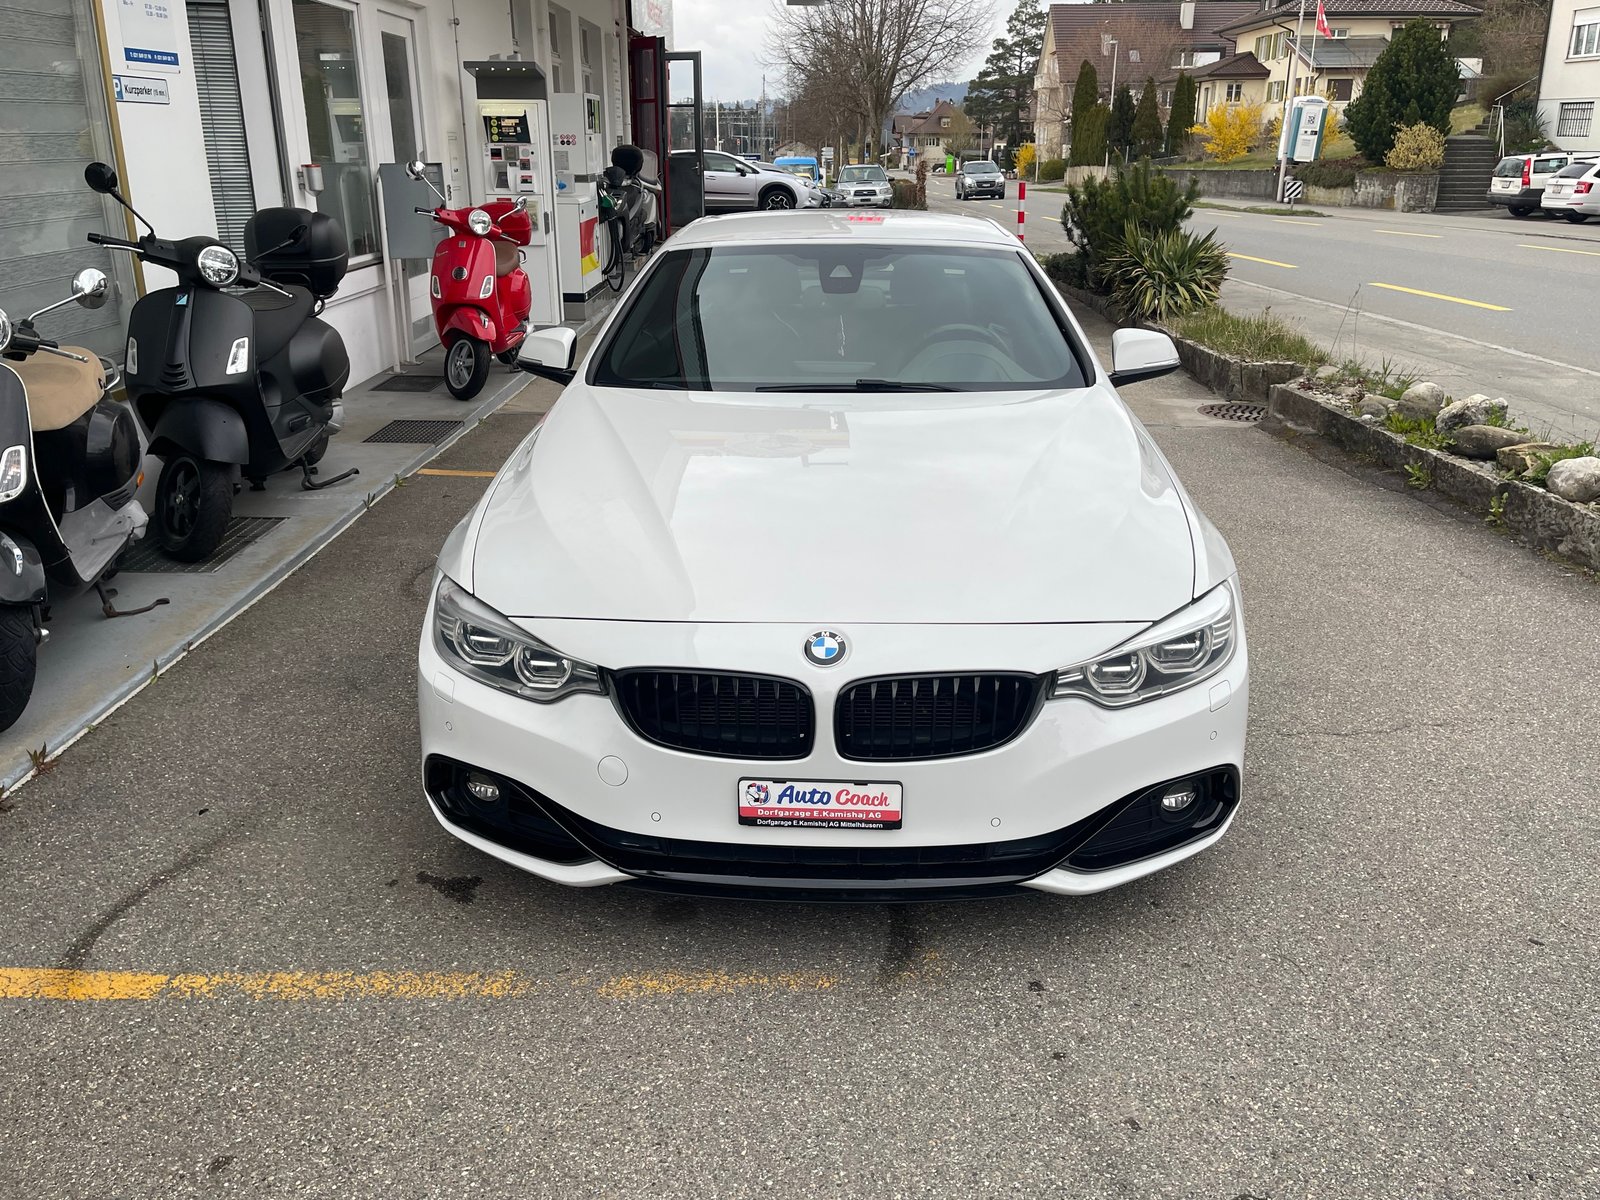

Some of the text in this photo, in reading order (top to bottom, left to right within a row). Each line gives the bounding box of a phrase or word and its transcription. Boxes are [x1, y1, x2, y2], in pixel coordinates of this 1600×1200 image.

[124, 84, 153, 96] Kurzparker
[808, 630, 844, 643] BMW
[777, 785, 890, 807] Auto Coach
[757, 808, 882, 819] Dorfgarage E.Kamishaj AG
[757, 818, 792, 827] Dorfgarage
[793, 820, 828, 828] E.Kamishaj
[840, 821, 883, 829] Mittelhäusern
